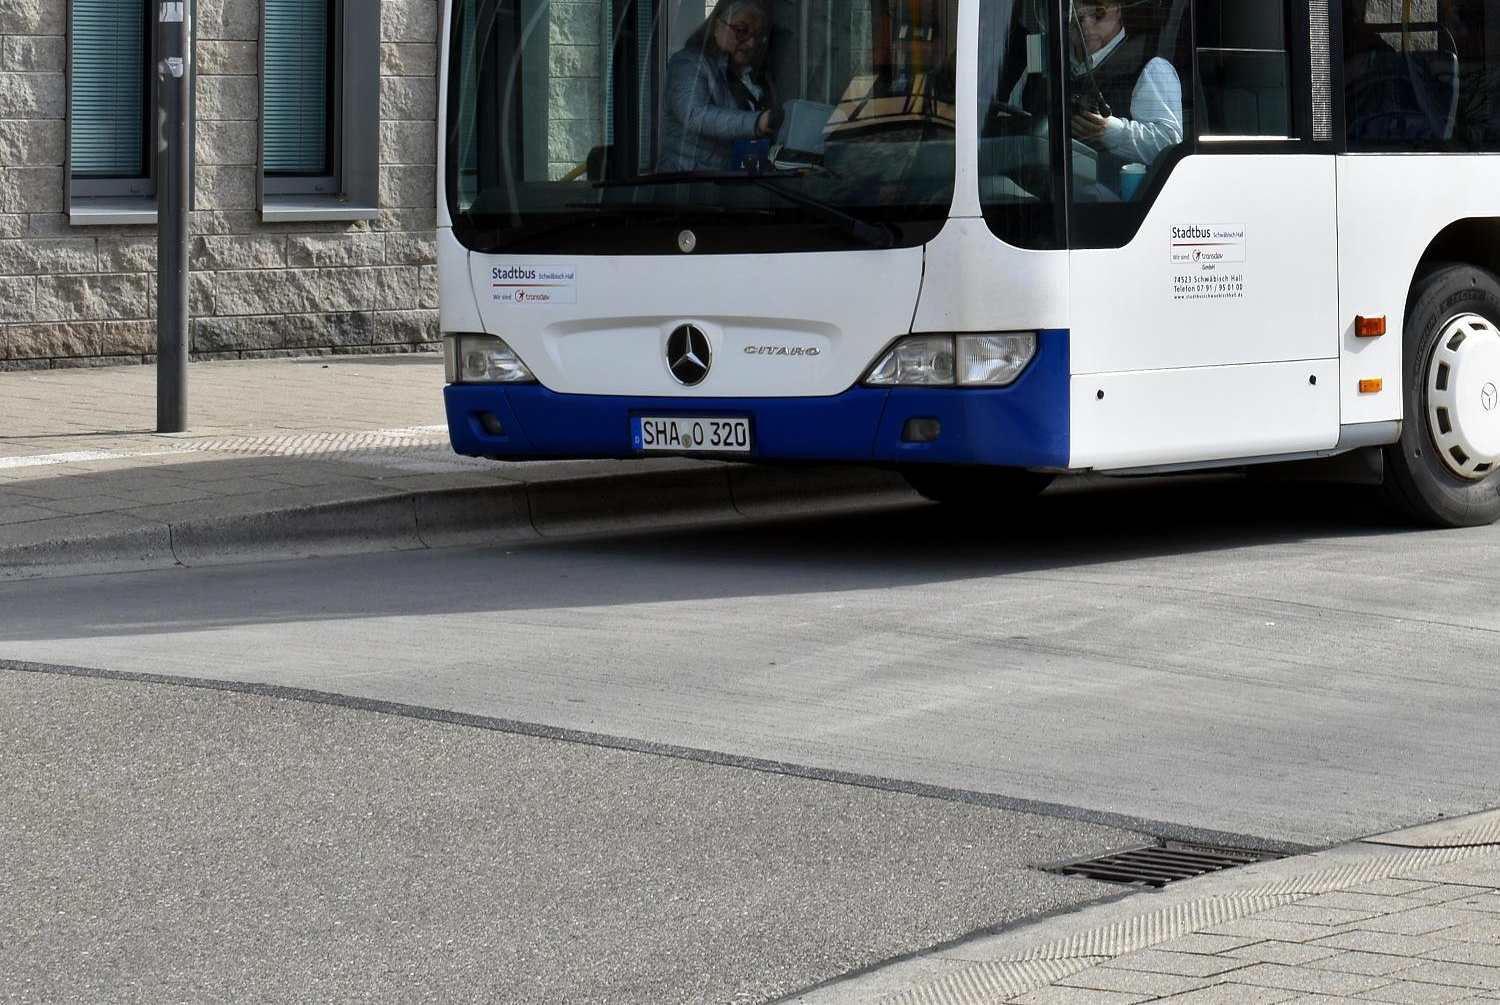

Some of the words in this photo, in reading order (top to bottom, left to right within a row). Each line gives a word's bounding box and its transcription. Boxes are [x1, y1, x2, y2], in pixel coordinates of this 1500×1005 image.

[1172, 225, 1211, 238] Stadtbus
[492, 266, 536, 279] Stadtbus
[1193, 274, 1229, 283] Schwäbisch
[1230, 274, 1242, 282] Hall
[1174, 285, 1196, 293] Telefon
[1196, 284, 1204, 292] 07
[1205, 284, 1212, 292] 91
[1218, 283, 1226, 292] 95
[525, 292, 551, 300] transdev
[743, 345, 821, 356] CITARO
[643, 421, 681, 446] SHA
[709, 422, 748, 447] 320
